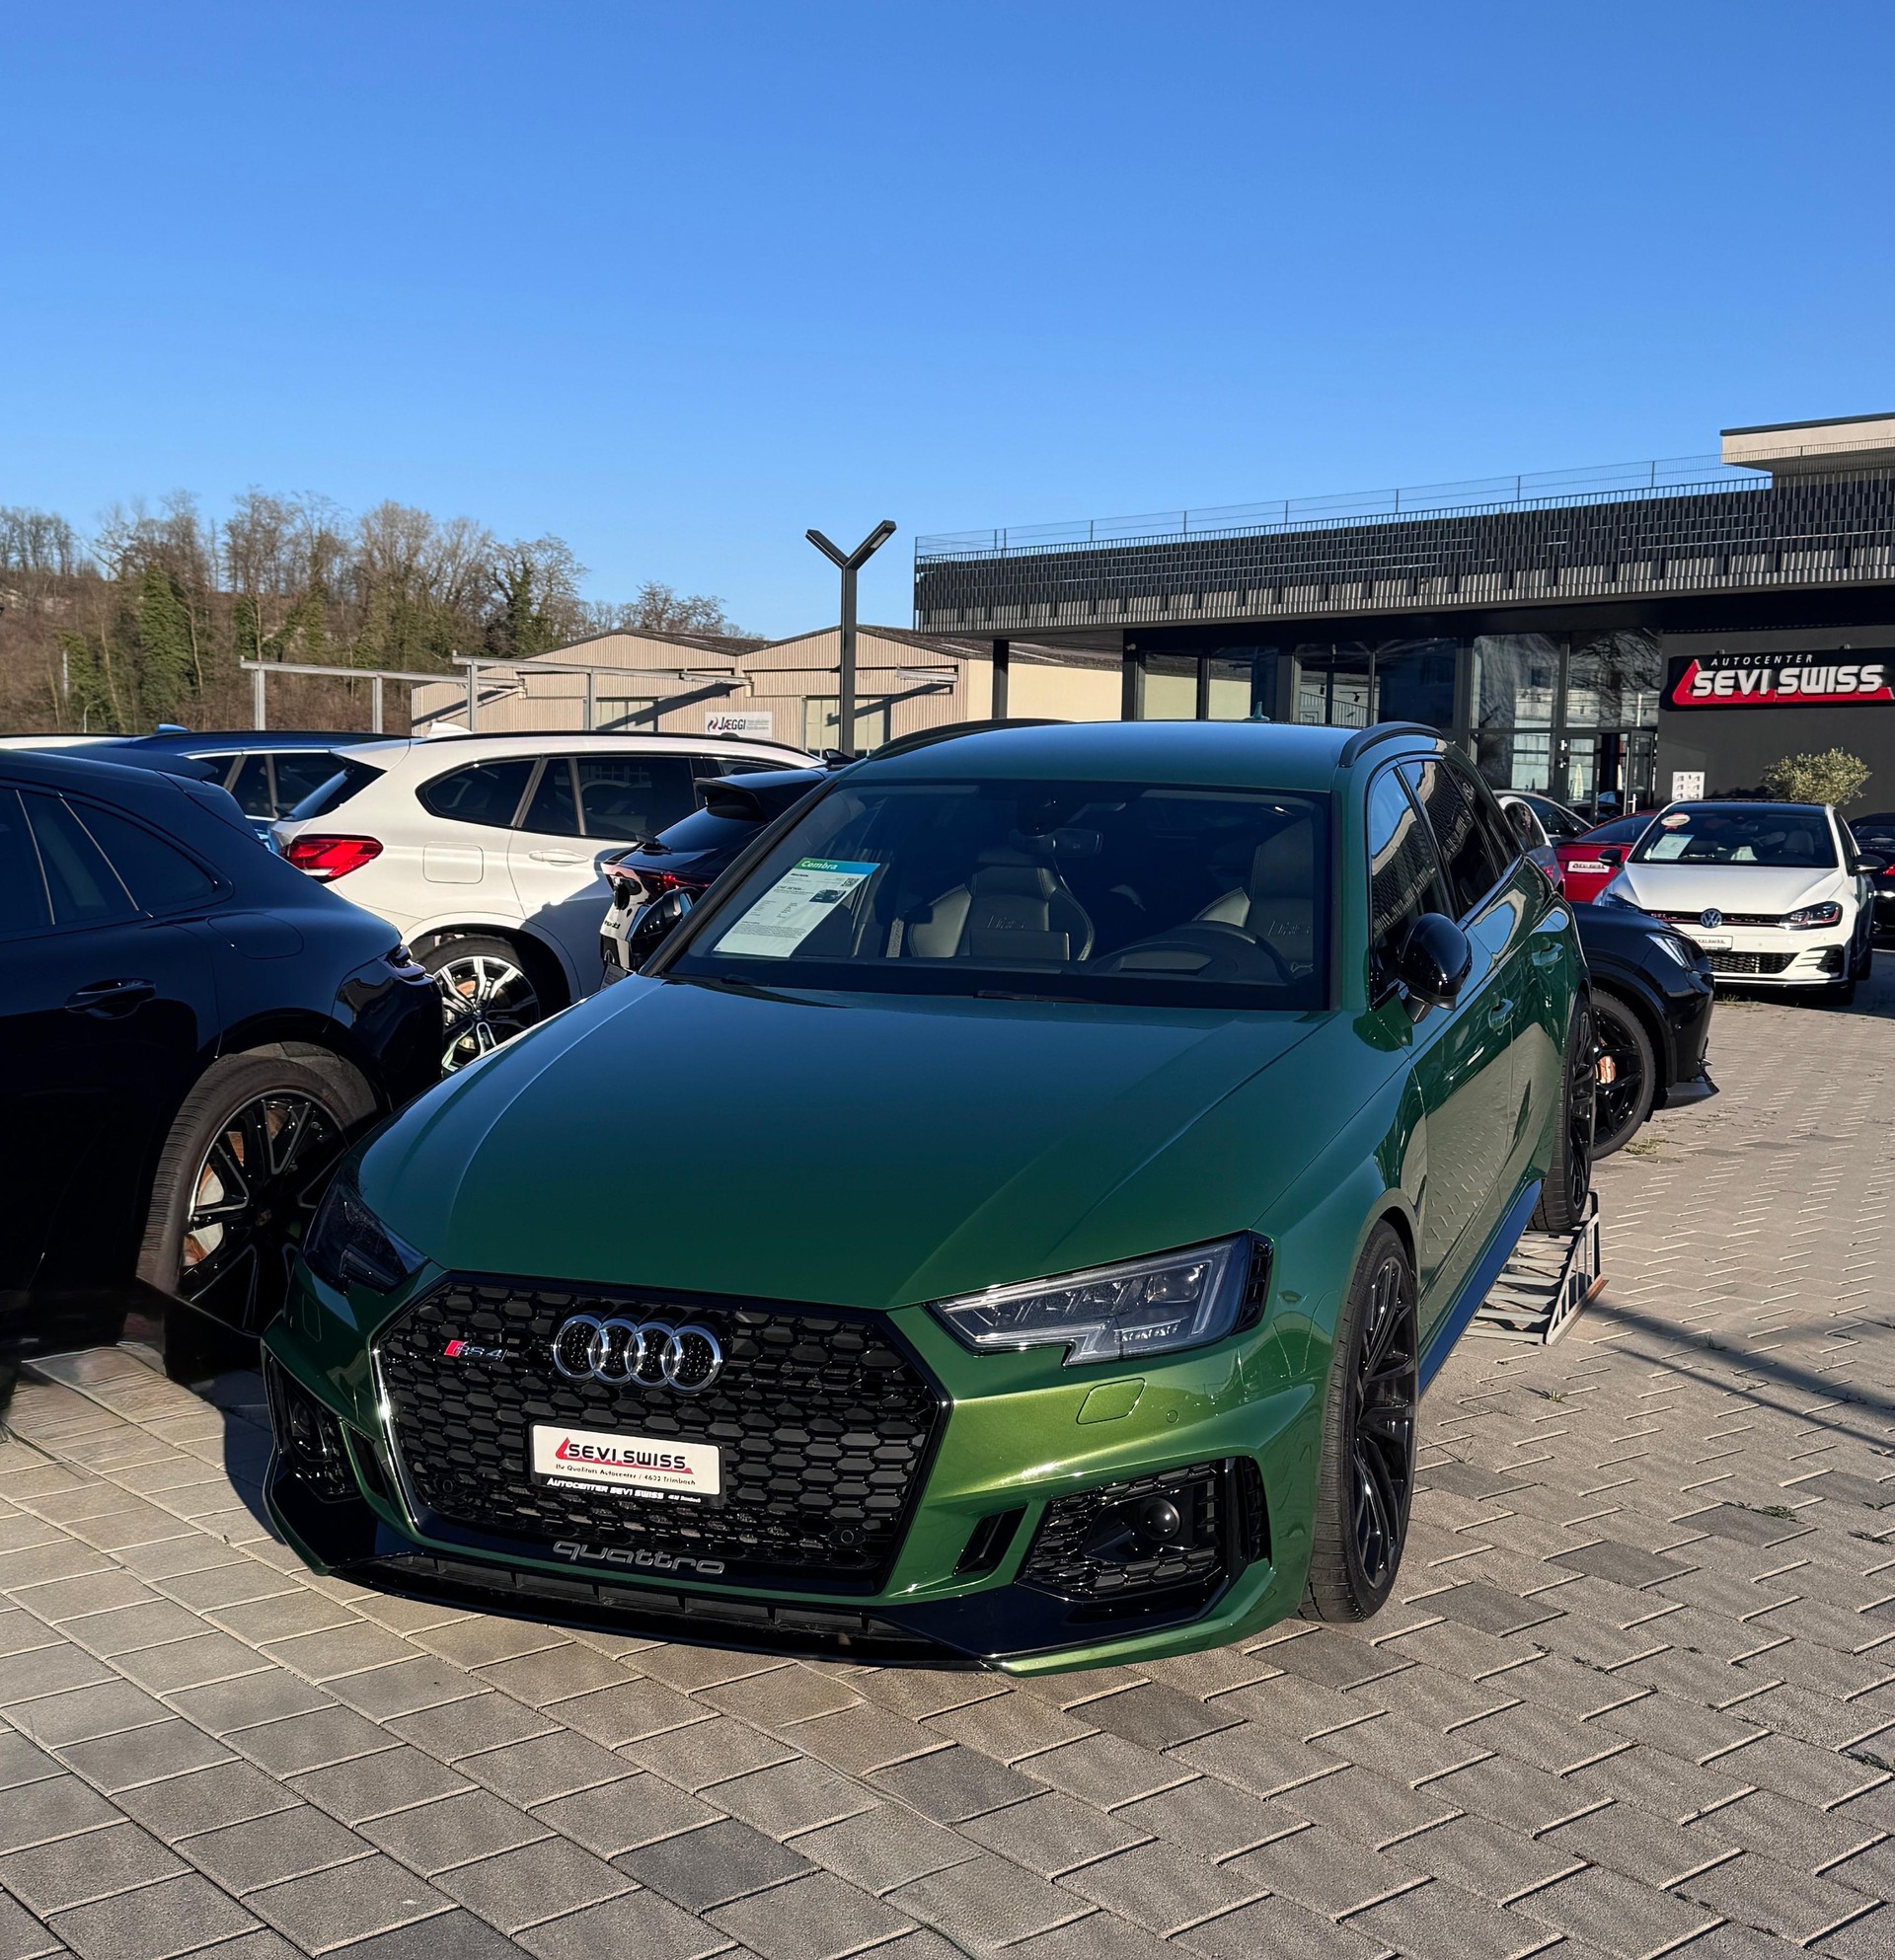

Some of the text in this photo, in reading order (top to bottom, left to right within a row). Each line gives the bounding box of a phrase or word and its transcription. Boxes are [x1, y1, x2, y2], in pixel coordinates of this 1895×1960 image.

[1710, 653, 1813, 667] AUTOCENTER
[1692, 664, 1885, 697] SEVI SWISS
[800, 861, 838, 870] Cembra
[568, 1443, 686, 1470] SEVI SWISS
[552, 1540, 725, 1575] quattro
